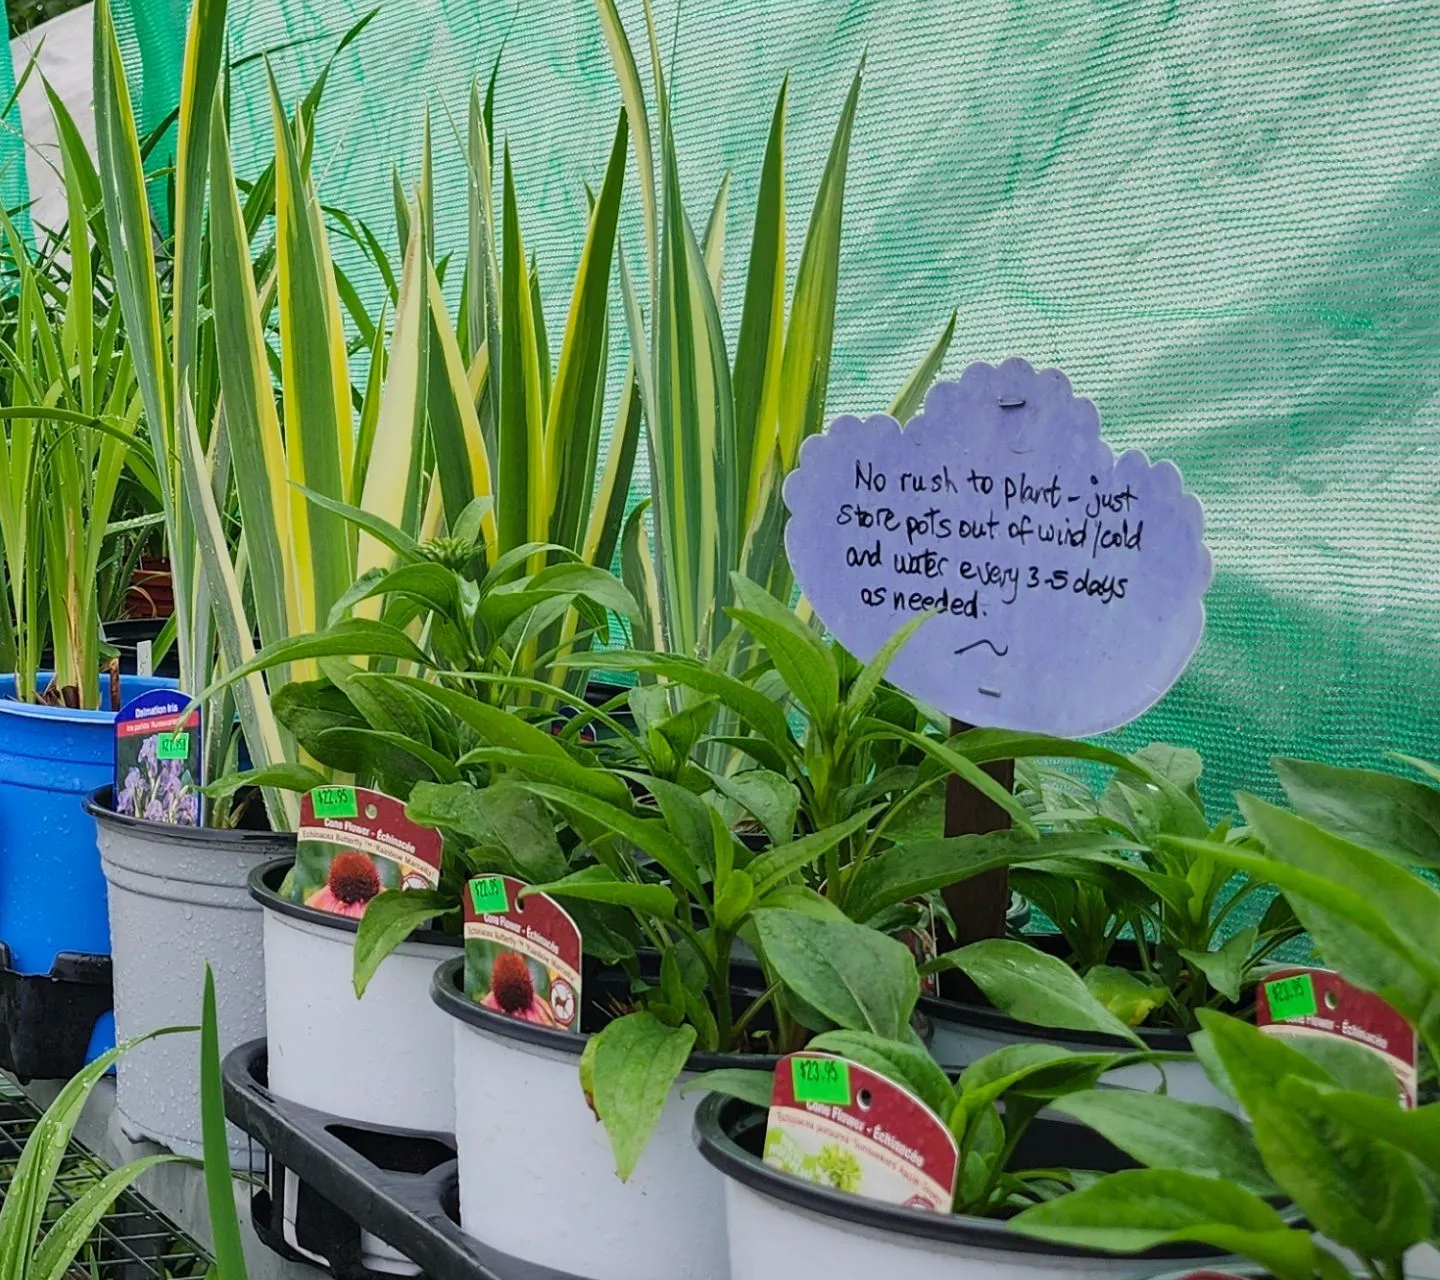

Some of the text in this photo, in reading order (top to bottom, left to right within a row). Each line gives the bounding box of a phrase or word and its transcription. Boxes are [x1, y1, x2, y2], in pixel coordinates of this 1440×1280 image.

[855, 459, 886, 492] No
[900, 465, 958, 493] rush
[967, 469, 994, 494] to
[1004, 472, 1062, 511] plant
[1086, 475, 1139, 518] just
[837, 503, 901, 532] store
[906, 507, 952, 545] pots
[958, 509, 1000, 539] out
[1008, 514, 1033, 545] of
[846, 539, 882, 567] and
[894, 548, 949, 578] water
[959, 561, 1019, 604] every
[1073, 568, 1128, 604] days
[861, 586, 887, 606] as
[324, 818, 343, 829] Cone
[344, 821, 370, 836] Flower
[799, 1060, 838, 1082] $23.95
[831, 1106, 865, 1133] Flower
